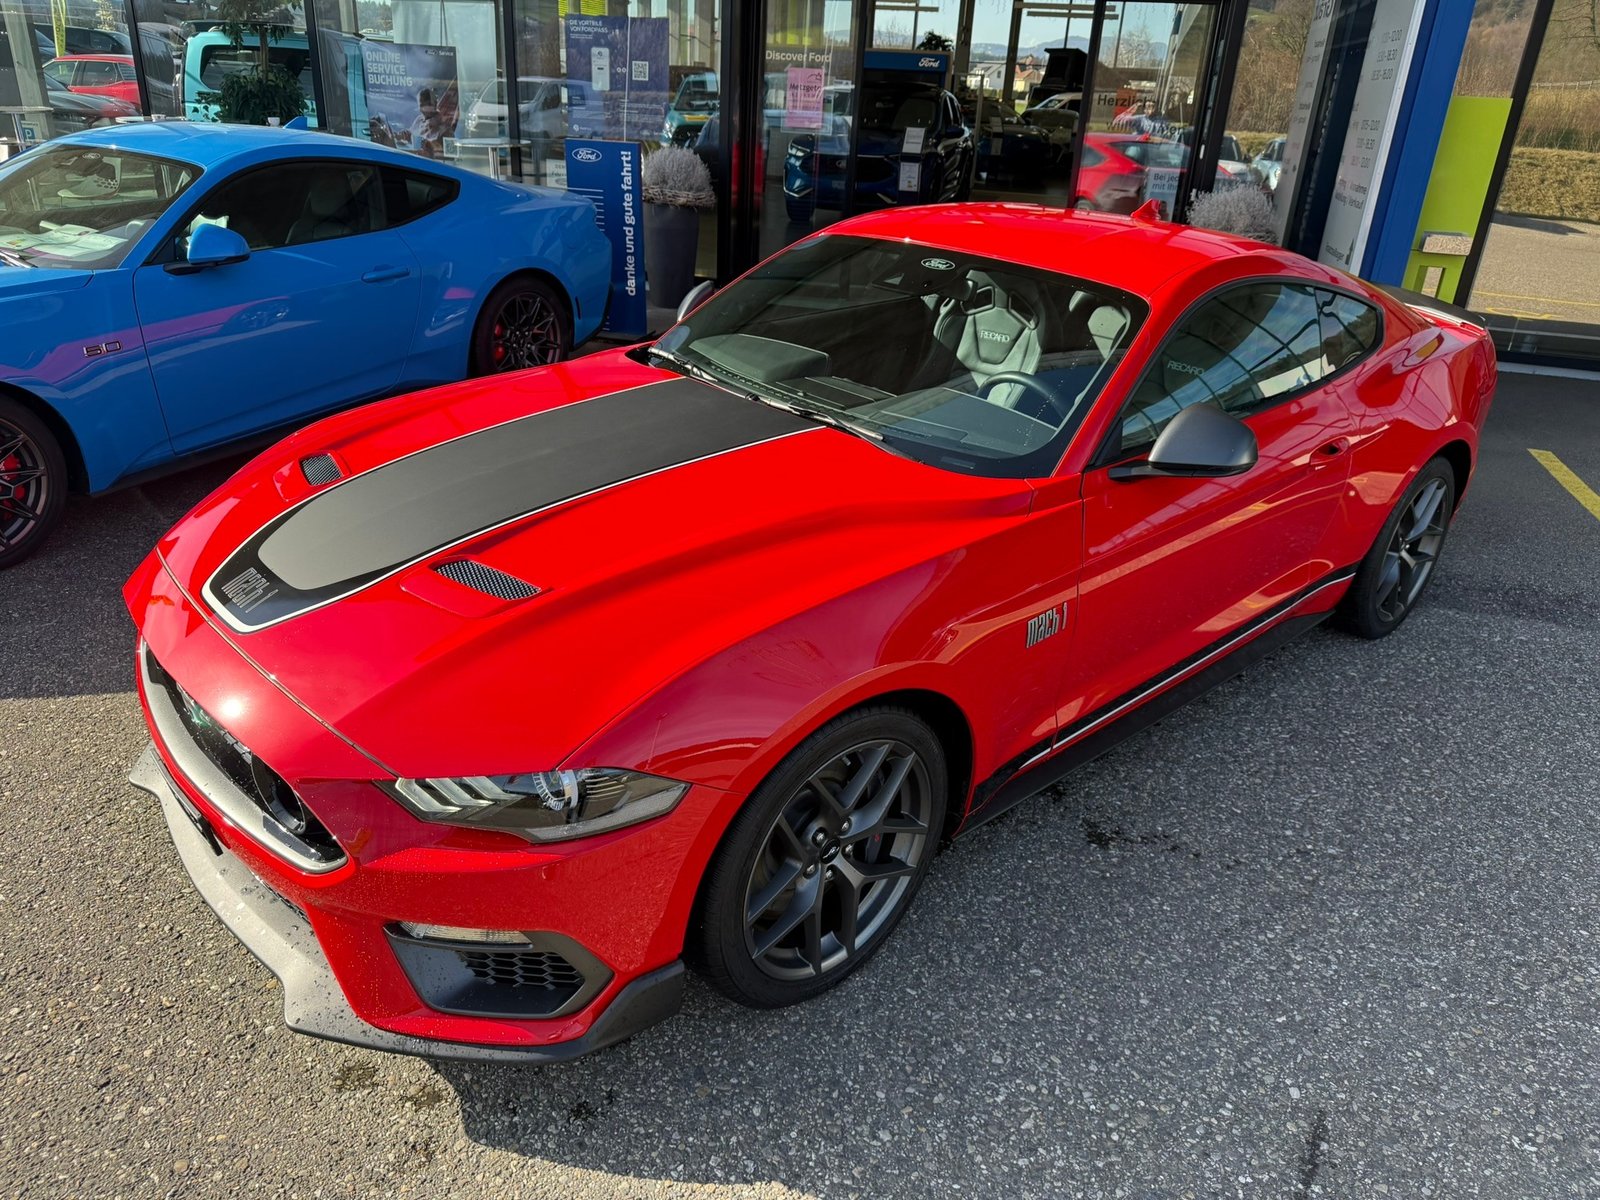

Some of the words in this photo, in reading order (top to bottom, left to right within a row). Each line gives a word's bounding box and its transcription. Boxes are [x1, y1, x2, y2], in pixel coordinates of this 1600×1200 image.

[366, 51, 401, 63] ONLINE
[765, 50, 807, 62] Discover
[809, 52, 832, 63] Ford
[918, 57, 940, 68] Ford
[367, 63, 405, 75] SERVICE
[368, 74, 413, 87] BUCHUNG
[575, 149, 599, 161] Ford
[620, 151, 632, 192] fahrt!
[1153, 173, 1166, 181] Bei
[623, 194, 635, 225] gute
[623, 226, 634, 253] und
[924, 259, 952, 270] Ford
[625, 255, 636, 296] danke
[980, 330, 1010, 343] RECARO
[1167, 360, 1205, 376] RECARO
